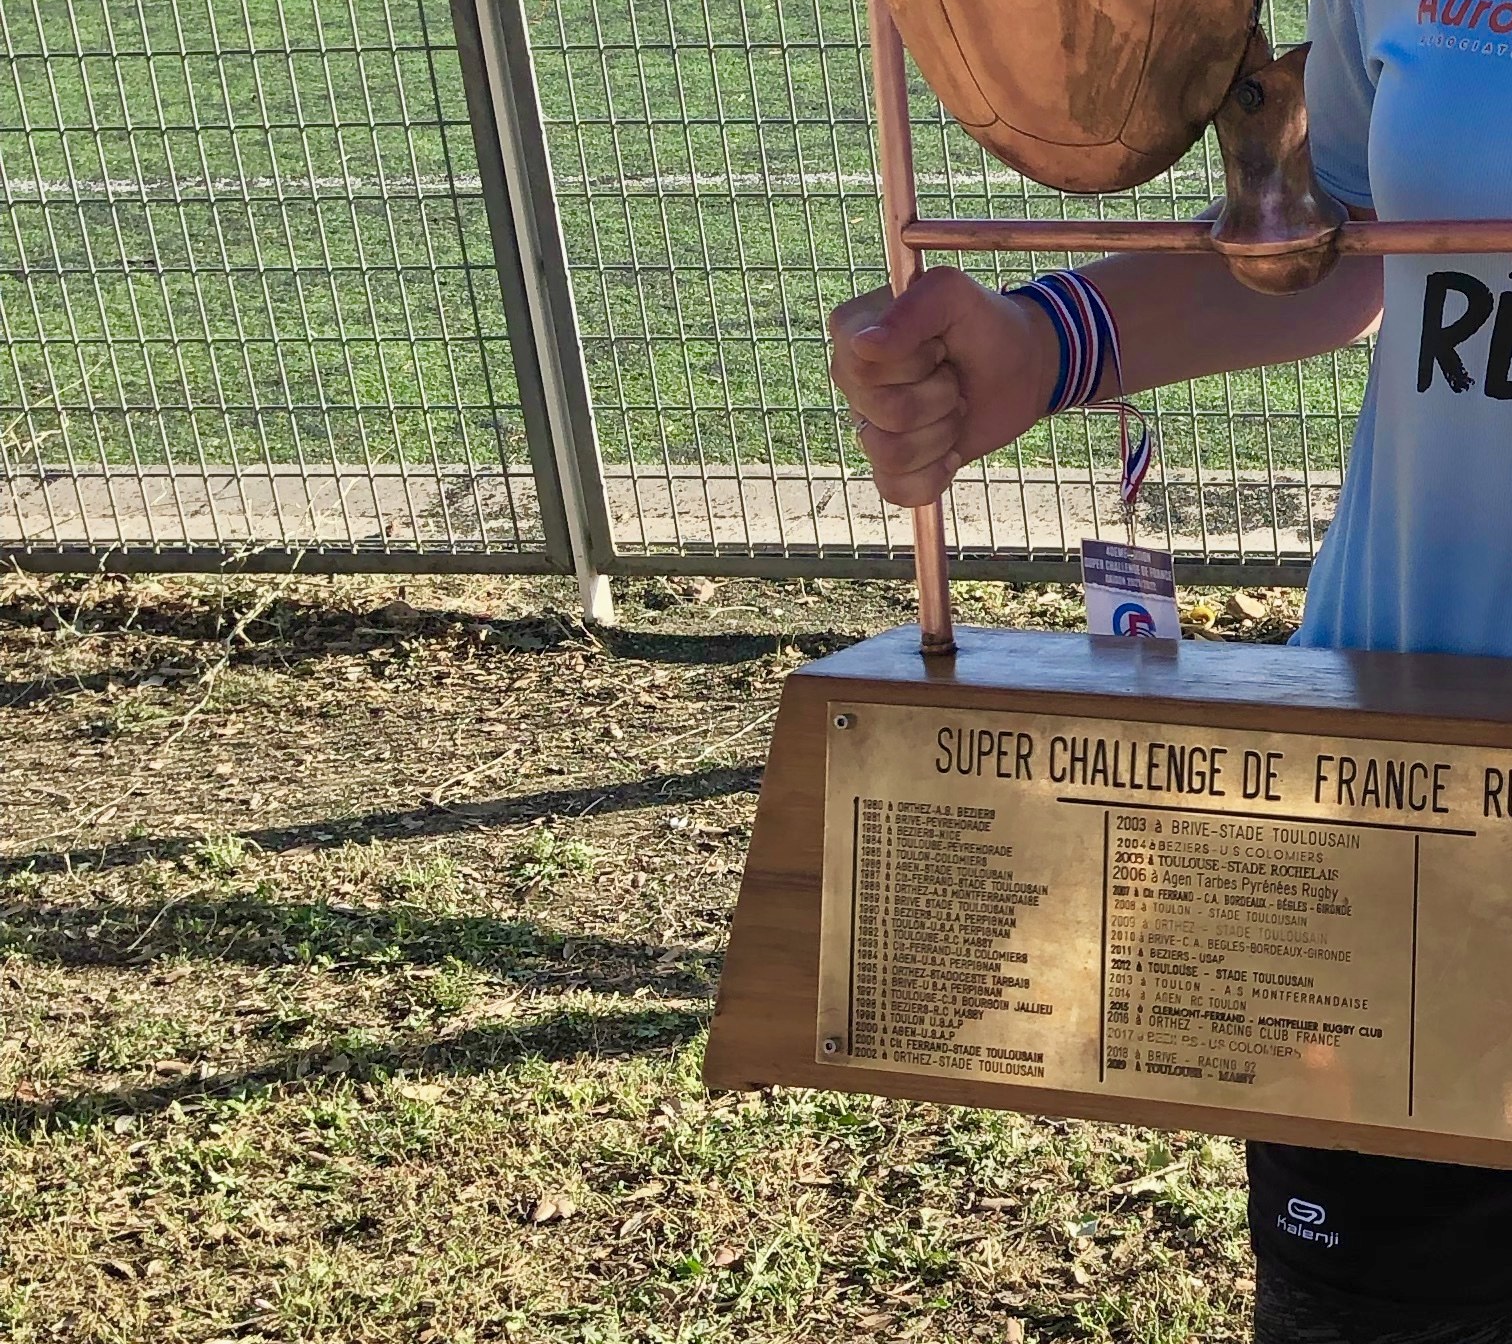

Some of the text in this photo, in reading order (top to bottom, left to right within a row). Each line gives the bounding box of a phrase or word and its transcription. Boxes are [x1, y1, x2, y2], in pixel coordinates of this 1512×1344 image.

[935, 727, 1033, 783] SUPER
[1049, 734, 1227, 797] CHALLENGE
[1242, 748, 1282, 801] DE
[1315, 752, 1450, 814] FRANCE
[1116, 815, 1146, 832] 2003
[1172, 819, 1263, 841] BRIVE-STADE
[1272, 827, 1359, 849] TOULOUSAIN
[1117, 836, 1145, 849] 2004
[1245, 846, 1322, 864] COLOMIERS
[1115, 851, 1143, 865] 2005
[1157, 854, 1266, 875] TOULOUSE-STADE
[1270, 863, 1338, 881] ROCHELAIS
[1113, 866, 1146, 884] 2006
[1162, 870, 1191, 888] Agen
[1196, 873, 1237, 892] Tarbes
[1241, 877, 1297, 897] Pyrénées
[1302, 882, 1338, 901] Rugby
[1114, 899, 1135, 911] 2008
[1153, 902, 1190, 916] TOULON
[1209, 907, 1239, 920] STADE
[1246, 910, 1306, 926] TOULOUSAIN
[1111, 929, 1135, 942] 2010
[1155, 918, 1194, 934] ORTHEZ
[1216, 924, 1250, 939] STADE
[1259, 928, 1327, 946] TOULOUSAIN
[1111, 943, 1131, 956] 2011
[1148, 961, 1198, 977] TOULOUSE
[1216, 968, 1246, 982] STADE
[1252, 971, 1313, 989] TOULOUSAIN
[1109, 986, 1130, 999] 2014
[1155, 991, 1181, 1005] AGEN
[1190, 995, 1202, 1007] RC
[1208, 996, 1246, 1011] TOULON
[1110, 973, 1132, 986] 2013
[1155, 977, 1200, 993] TOULON
[1252, 987, 1367, 1010] MONTFERRANDAISE
[890, 1012, 924, 1026] TOULON
[1149, 1015, 1189, 1031] ORTHEZ
[1211, 1022, 1251, 1037] RACING
[1260, 1027, 1288, 1041] CLUB
[1296, 1030, 1340, 1047] FRANCE
[1152, 1005, 1245, 1024] CLERMONT-FERRAND
[1258, 1016, 1318, 1031] MONTPELLIER
[1323, 1022, 1354, 1035] RUGBY
[1359, 1026, 1382, 1038] CLUB
[855, 1045, 1044, 1078] 2002 ORTHEZ-STADE TOULOUSAIN
[986, 1047, 1043, 1064] TOULOUSAIN
[1107, 1046, 1127, 1058] 2018
[1148, 1050, 1176, 1063] BRIVE
[1198, 1056, 1236, 1070] RACING
[1277, 1215, 1339, 1248] Kalenji
